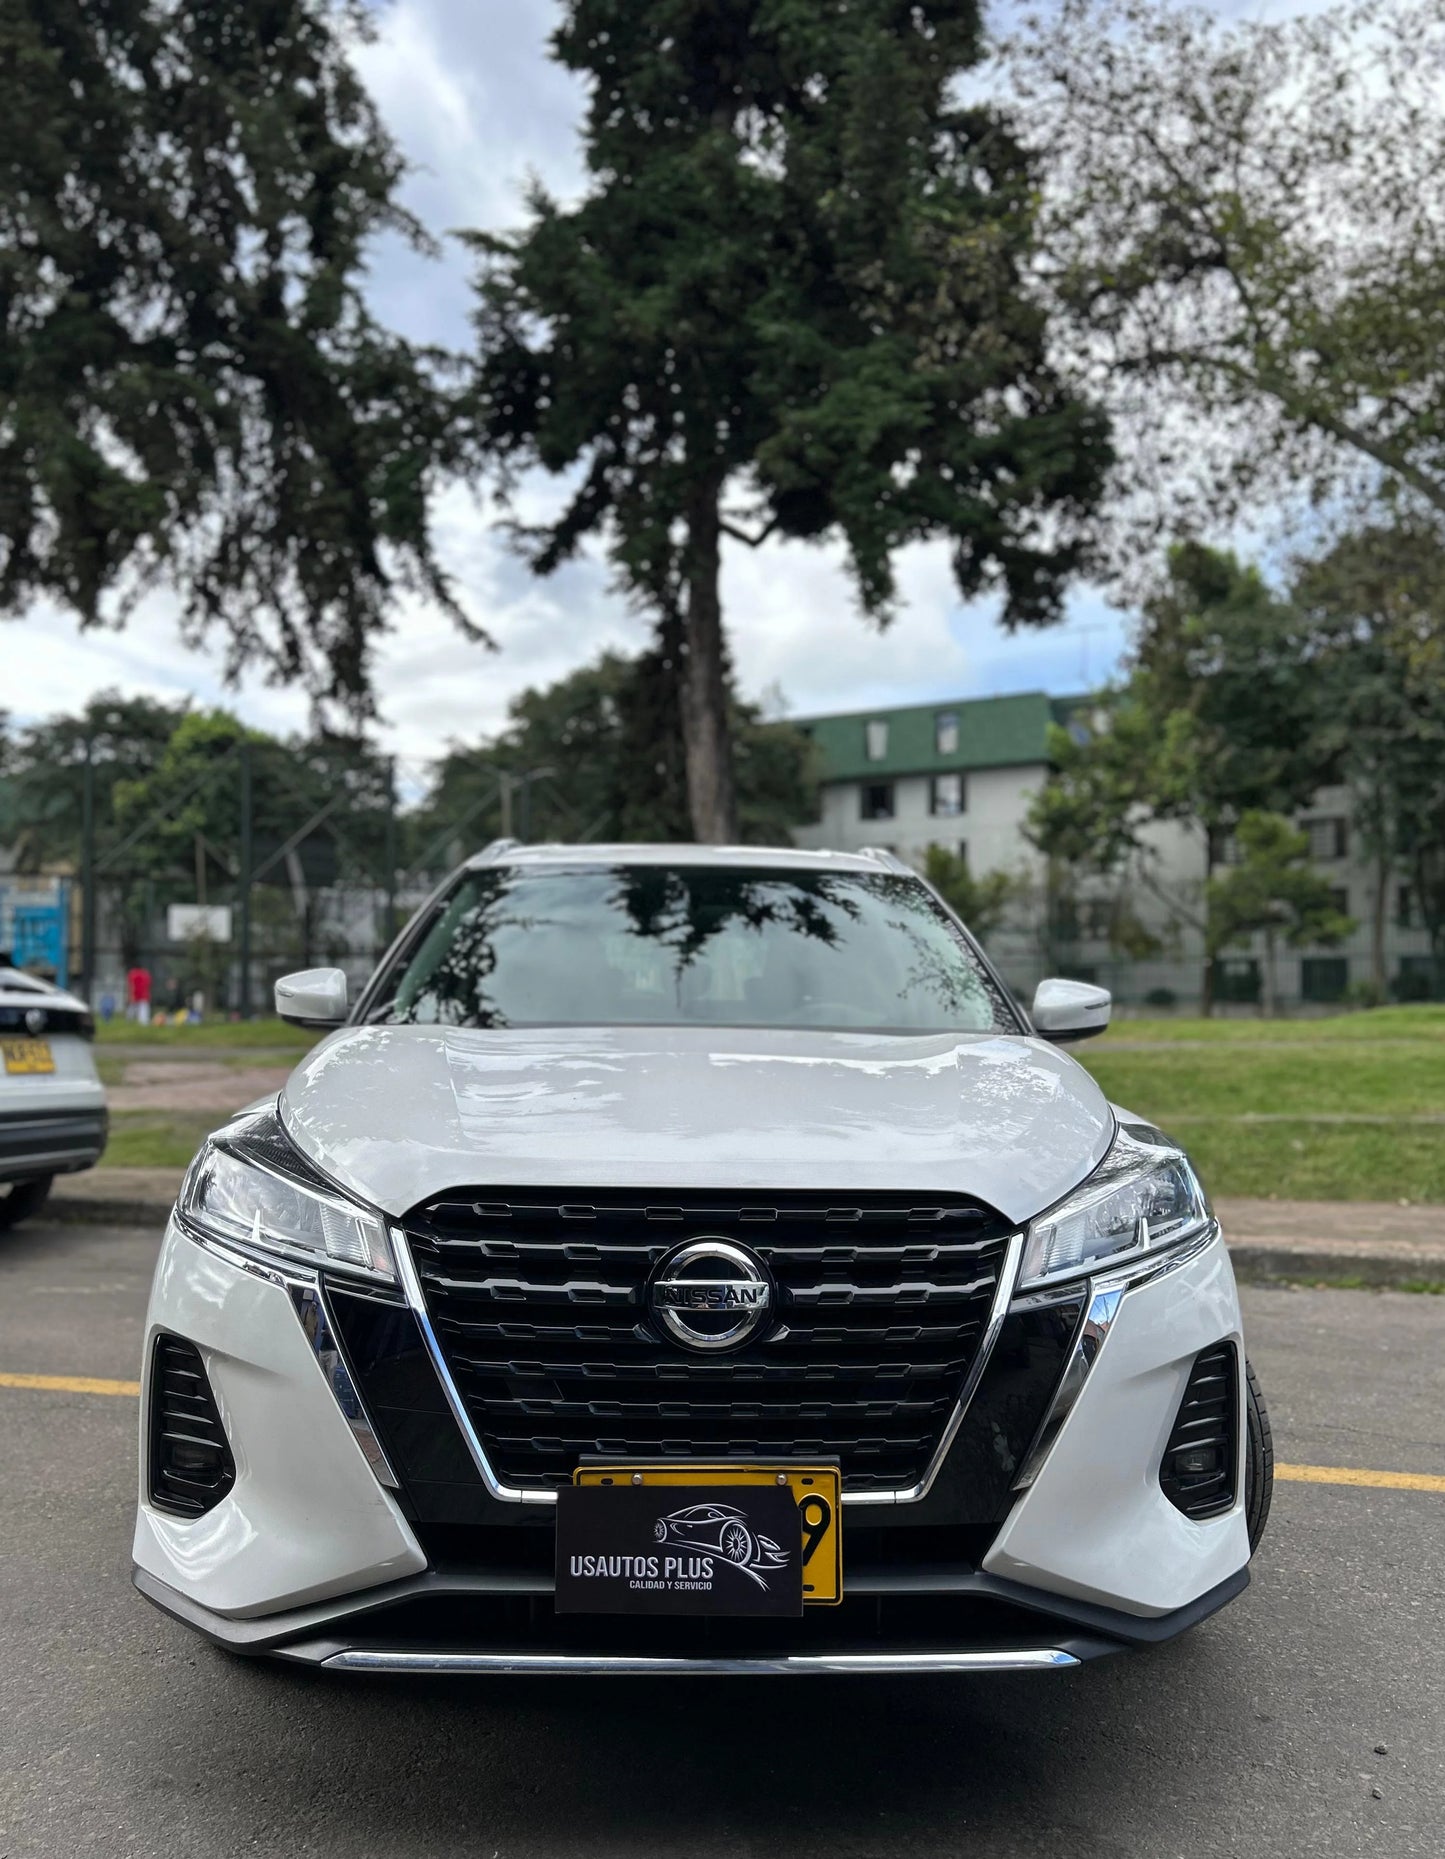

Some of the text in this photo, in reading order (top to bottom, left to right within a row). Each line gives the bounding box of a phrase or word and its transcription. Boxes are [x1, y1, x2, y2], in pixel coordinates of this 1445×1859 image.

[664, 1288, 757, 1304] NISSAN
[570, 1555, 714, 1579] USAUTOS PLUS
[629, 1580, 712, 1590] CALIDAD Y SERVICIO
